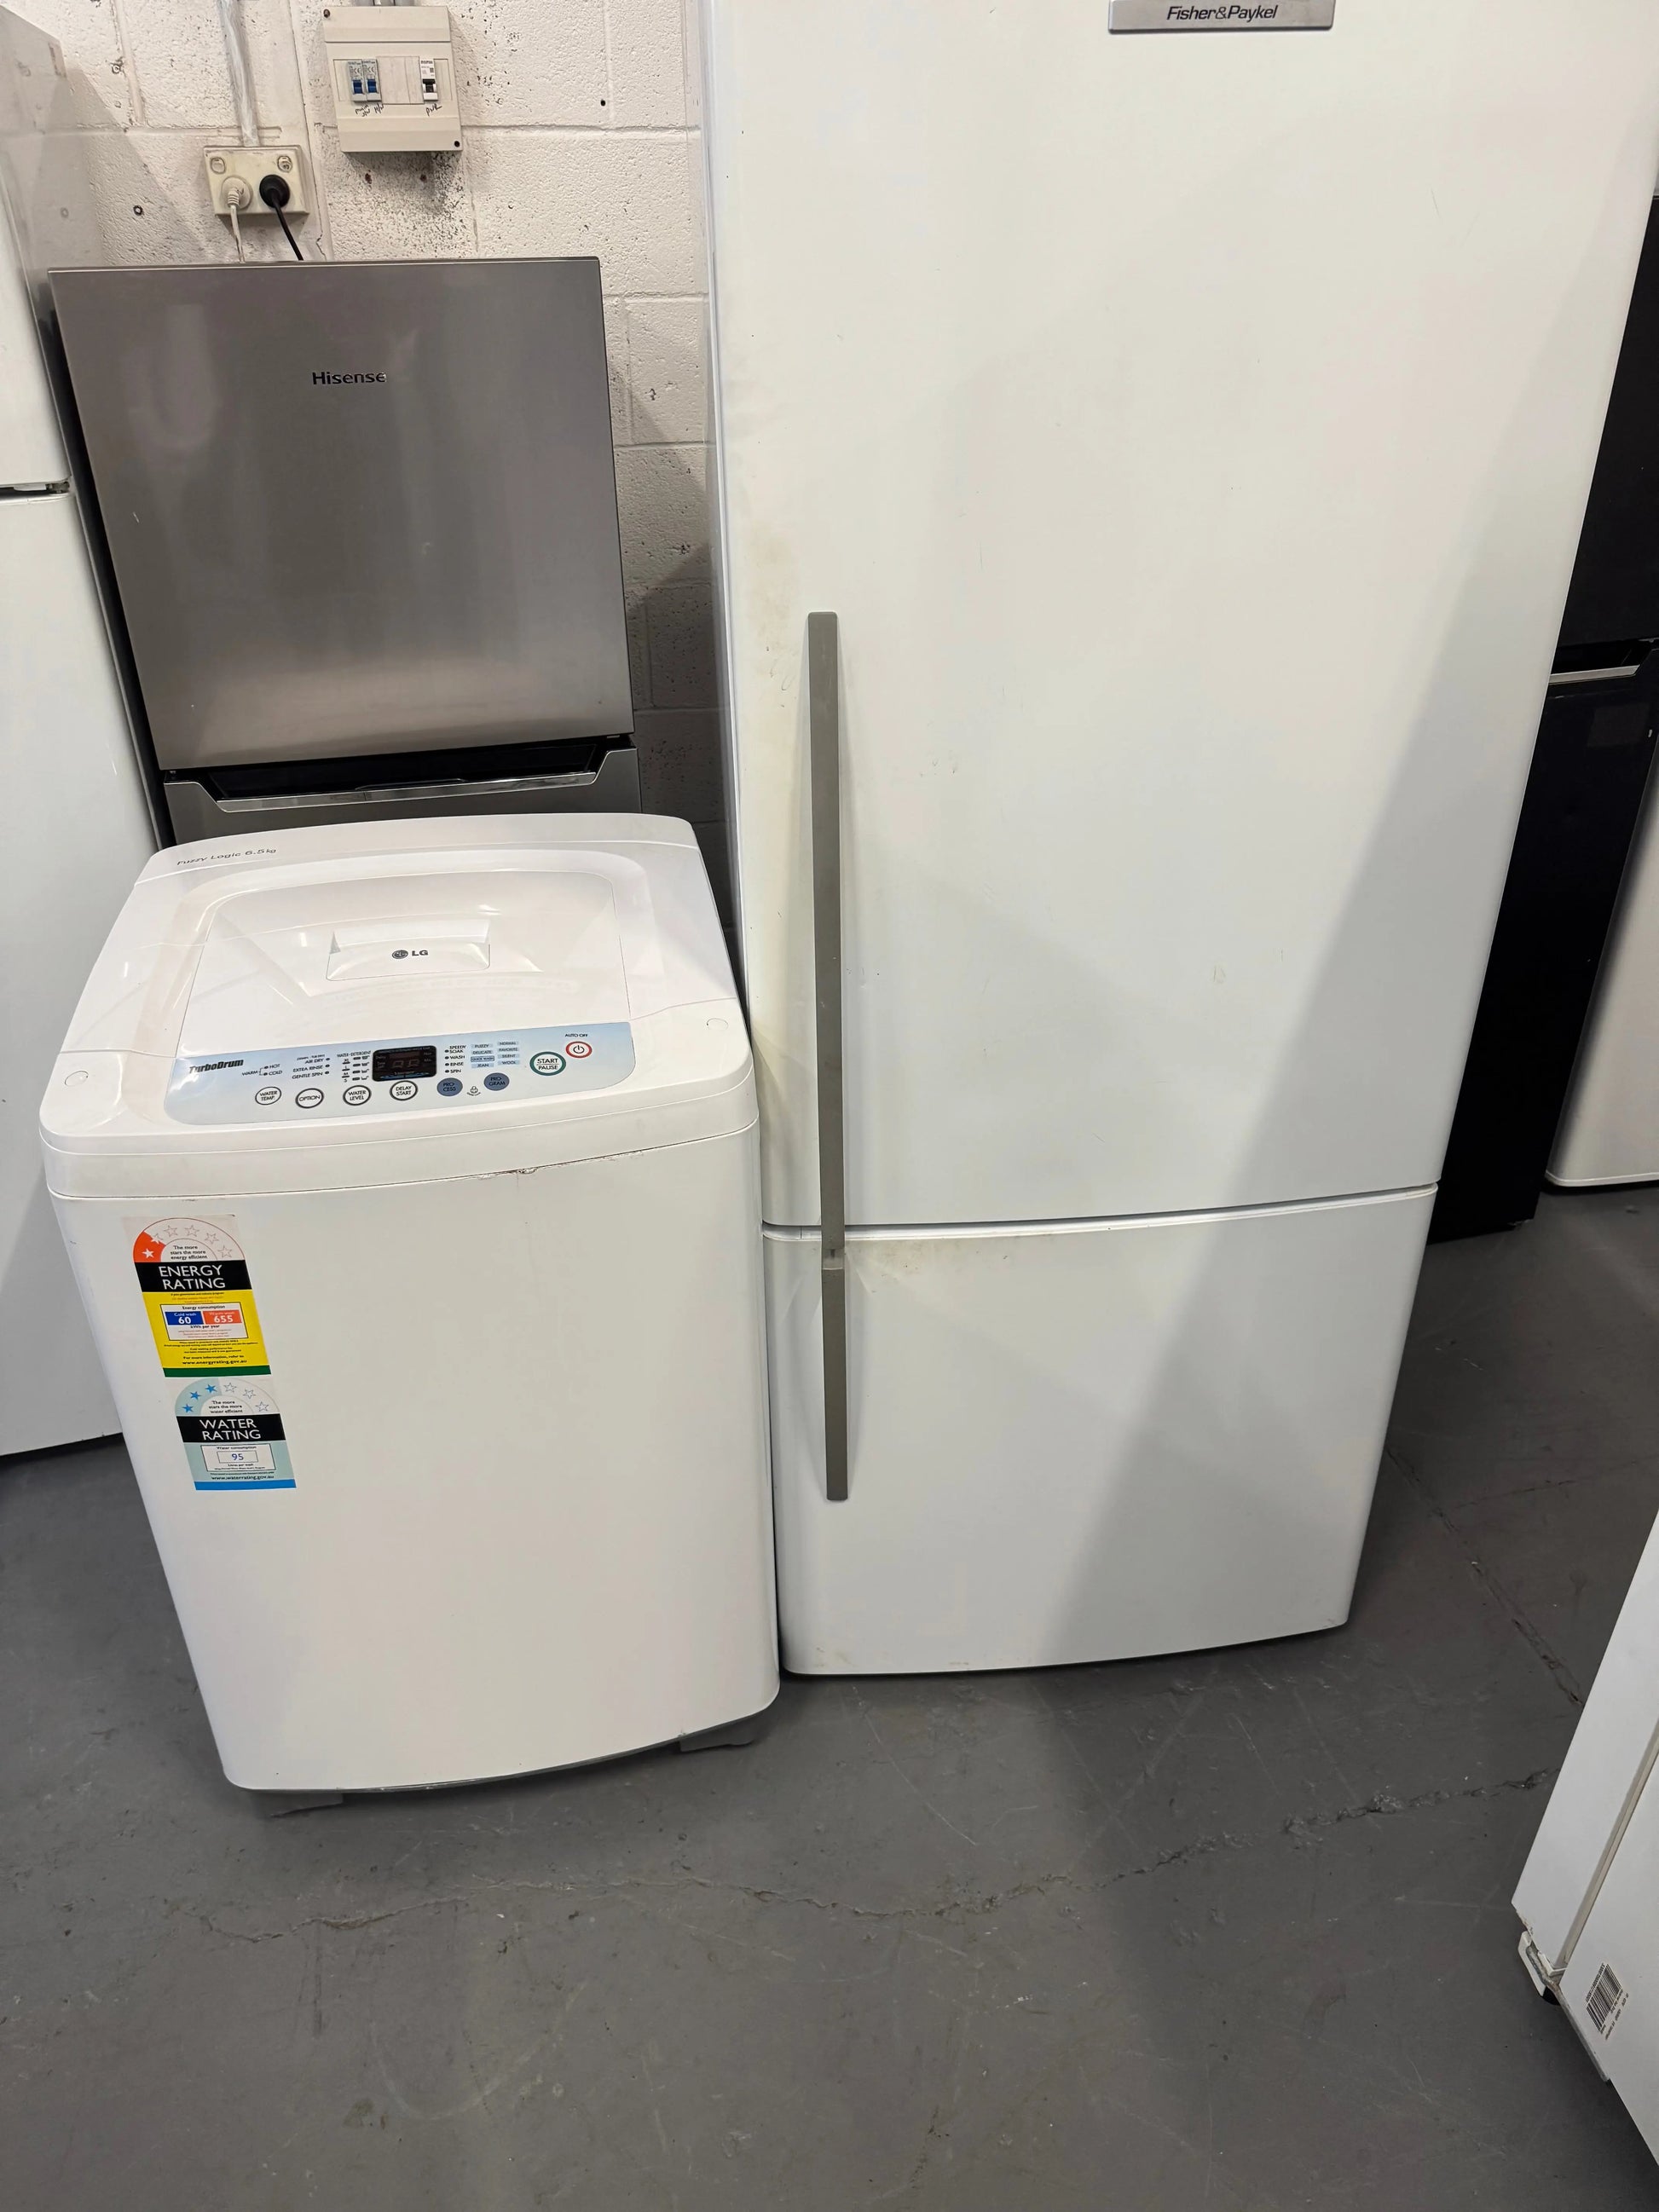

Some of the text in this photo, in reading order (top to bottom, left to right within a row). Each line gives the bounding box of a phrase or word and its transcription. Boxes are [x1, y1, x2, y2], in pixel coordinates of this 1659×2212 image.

[1166, 4, 1279, 23] Fisher&Paykel
[312, 371, 386, 385] Hisense
[176, 856, 208, 866] Fuzzy
[210, 852, 242, 861] Logic
[188, 1059, 245, 1074] TurboDrum
[158, 1264, 223, 1278] ENERGY
[163, 1278, 226, 1291] RATING
[177, 1316, 192, 1325] 60
[213, 1314, 234, 1323] 655
[199, 1418, 257, 1430] WATER
[201, 1429, 262, 1441] RATING
[231, 1453, 245, 1461] 95
